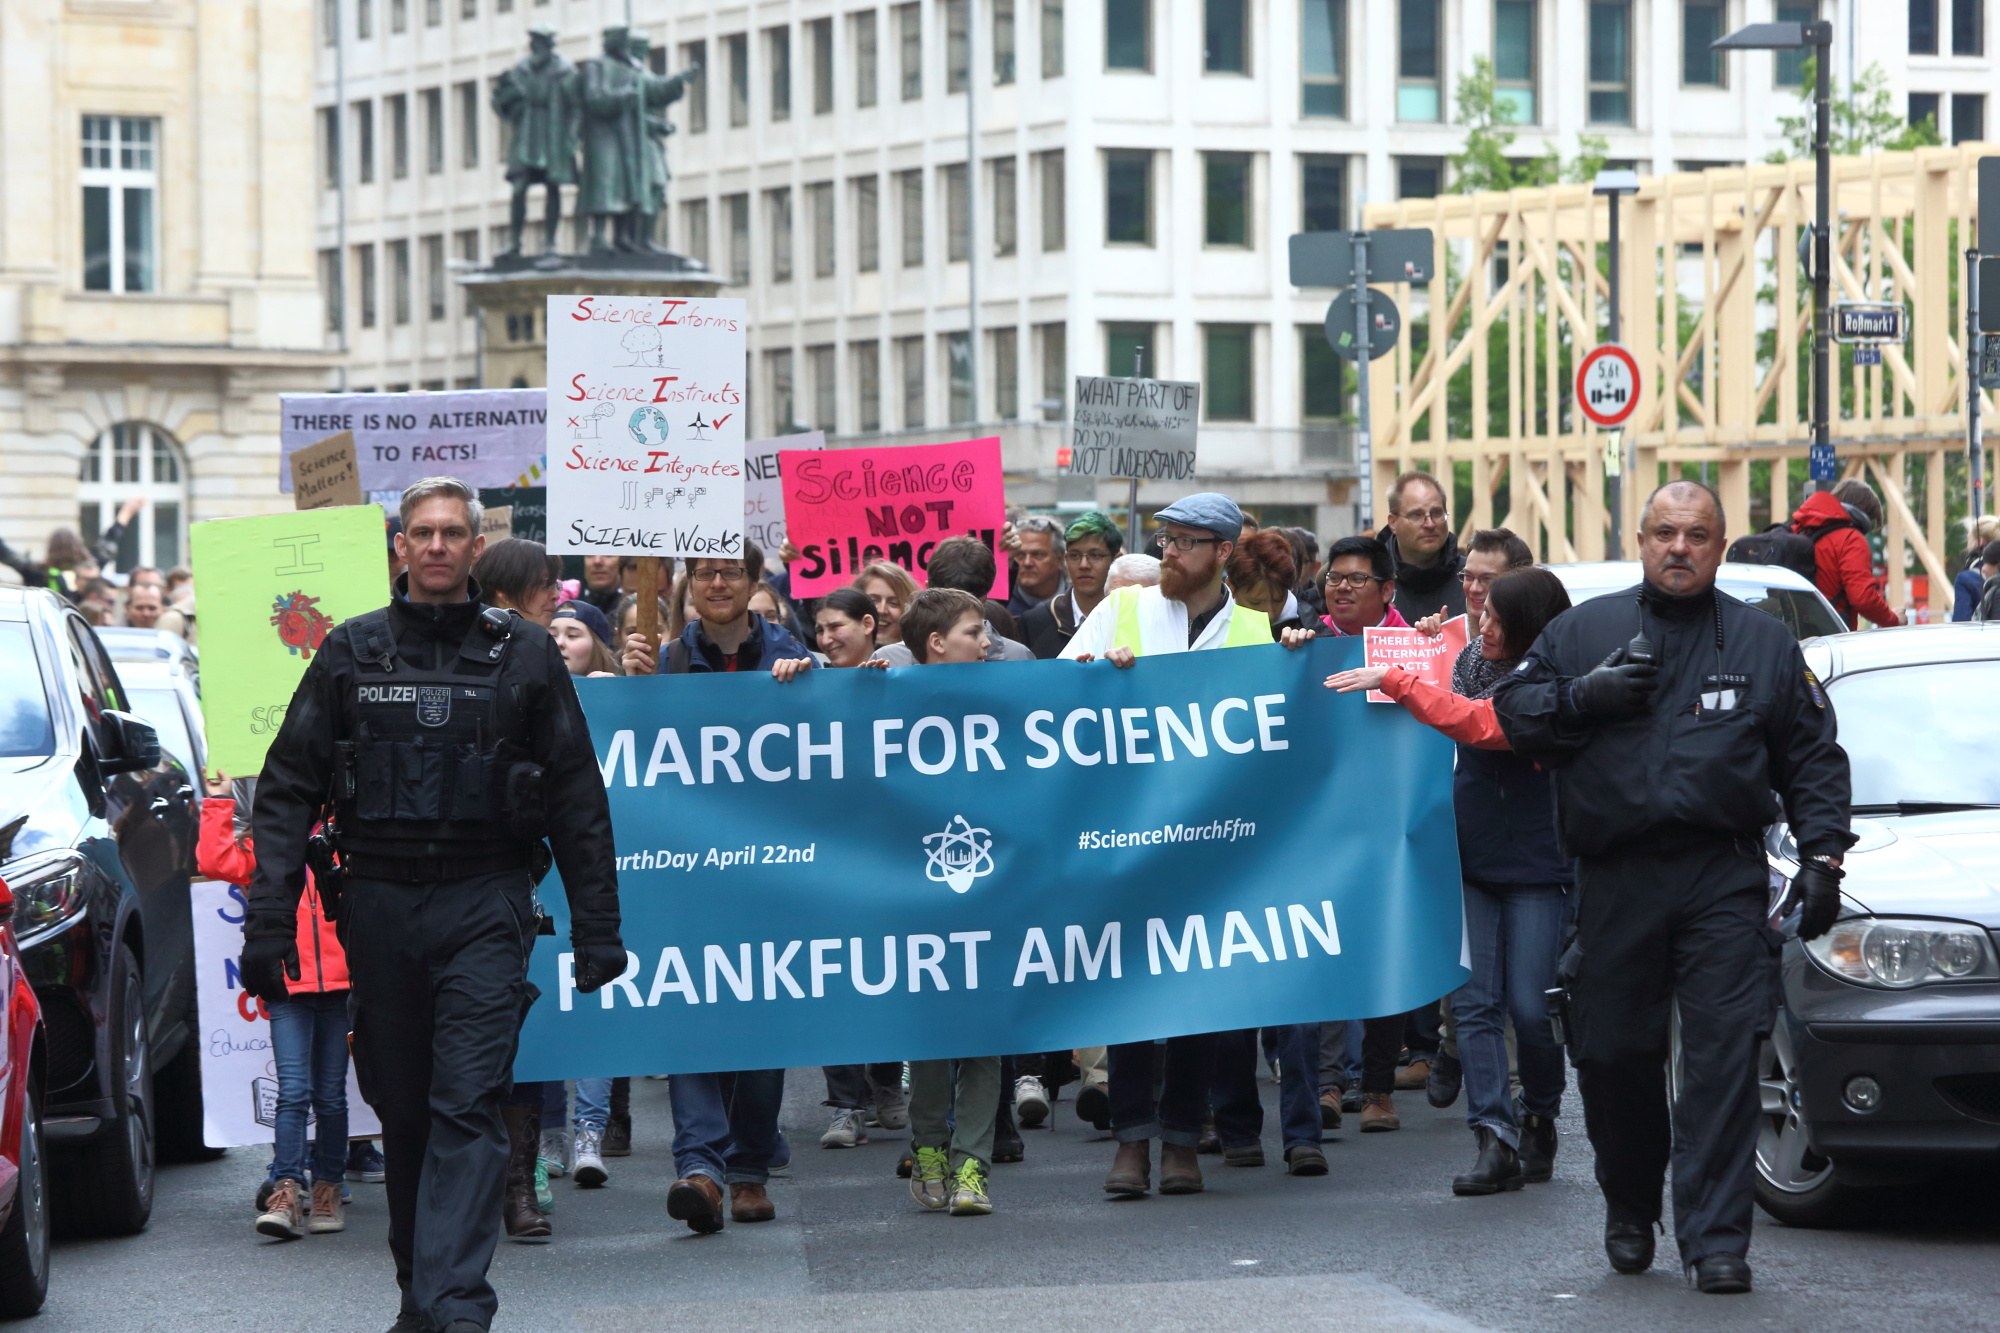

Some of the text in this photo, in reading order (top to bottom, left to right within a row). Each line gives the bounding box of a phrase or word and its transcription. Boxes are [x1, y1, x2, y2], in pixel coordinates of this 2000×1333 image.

[571, 297, 738, 332] Science Informs
[1845, 313, 1893, 334] Roßmarkt
[566, 373, 740, 405] Science Instructs
[1076, 377, 1195, 411] WHAT PART OF
[291, 409, 547, 430] THERE IS NO ALTERNATIV
[372, 443, 477, 462] TO FACTS!
[1073, 428, 1122, 448] DO YOU
[299, 449, 347, 477] Science
[565, 444, 740, 482] Science Integrates
[1070, 447, 1196, 481] NOT UNDERSTAND?
[795, 458, 975, 505] Science
[865, 500, 955, 538] NOT
[568, 519, 668, 549] SCIENCE
[273, 533, 324, 577] I
[1372, 632, 1444, 645] THERE IS NO
[1372, 644, 1447, 658] ALTERNATIVE
[358, 686, 417, 702] POLIZEI
[420, 688, 449, 697] POLIZEI
[464, 689, 477, 697] TILL
[596, 693, 1290, 788] MARCH FOR SCIENCE
[1078, 818, 1256, 850] #ScienceMarchFfm
[703, 845, 756, 870] April
[761, 843, 816, 864] 22nd
[1013, 921, 1122, 987] AM
[1146, 900, 1342, 975] MAIN
[209, 1029, 273, 1058] Educa
